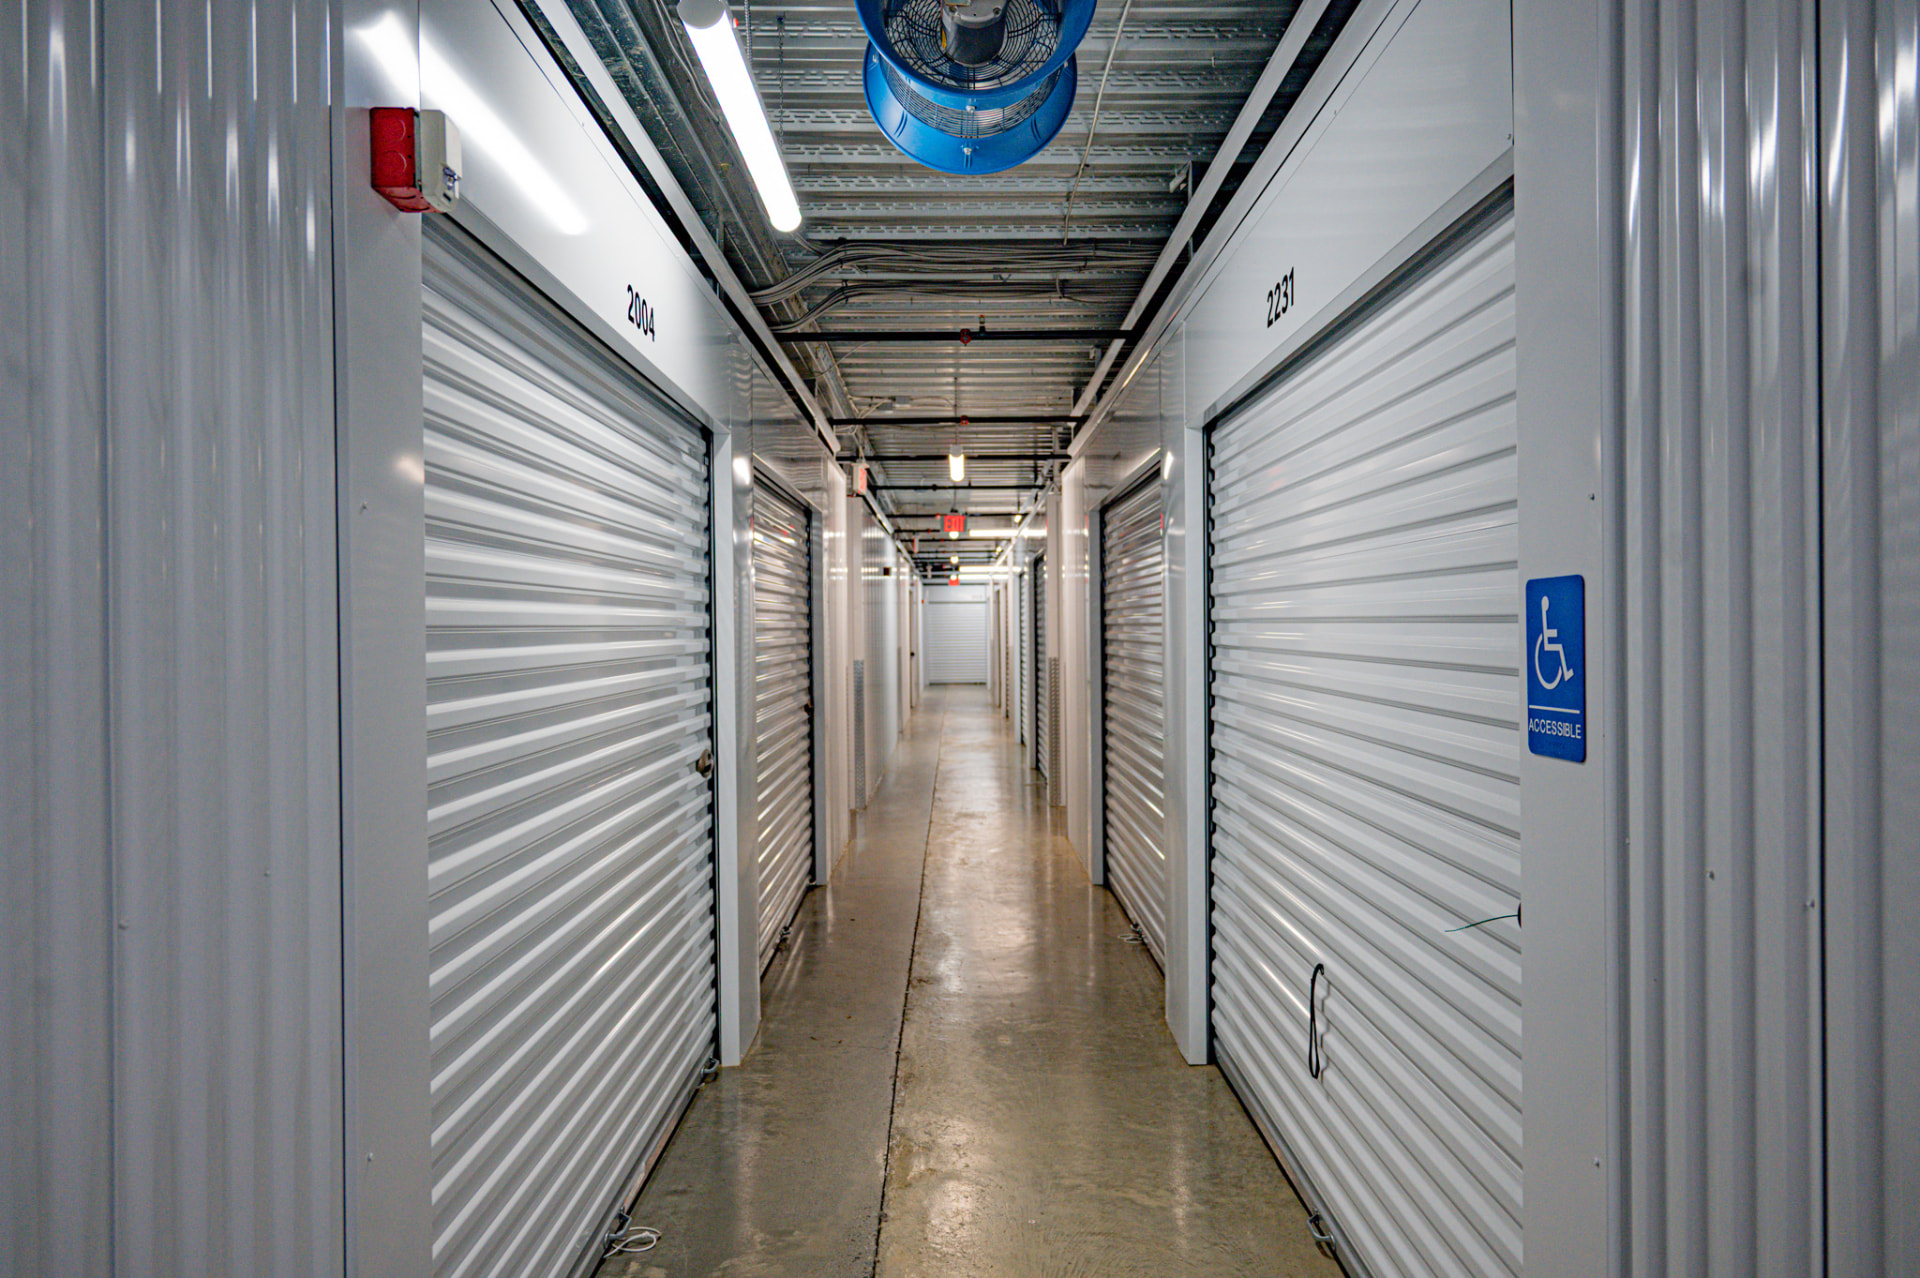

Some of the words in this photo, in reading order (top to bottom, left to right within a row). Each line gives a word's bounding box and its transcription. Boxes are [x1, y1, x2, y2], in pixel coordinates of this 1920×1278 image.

[627, 284, 655, 342] 2004
[1267, 266, 1294, 328] 2231
[944, 515, 966, 532] EXIT
[1529, 718, 1581, 739] ACCESSIBLE
